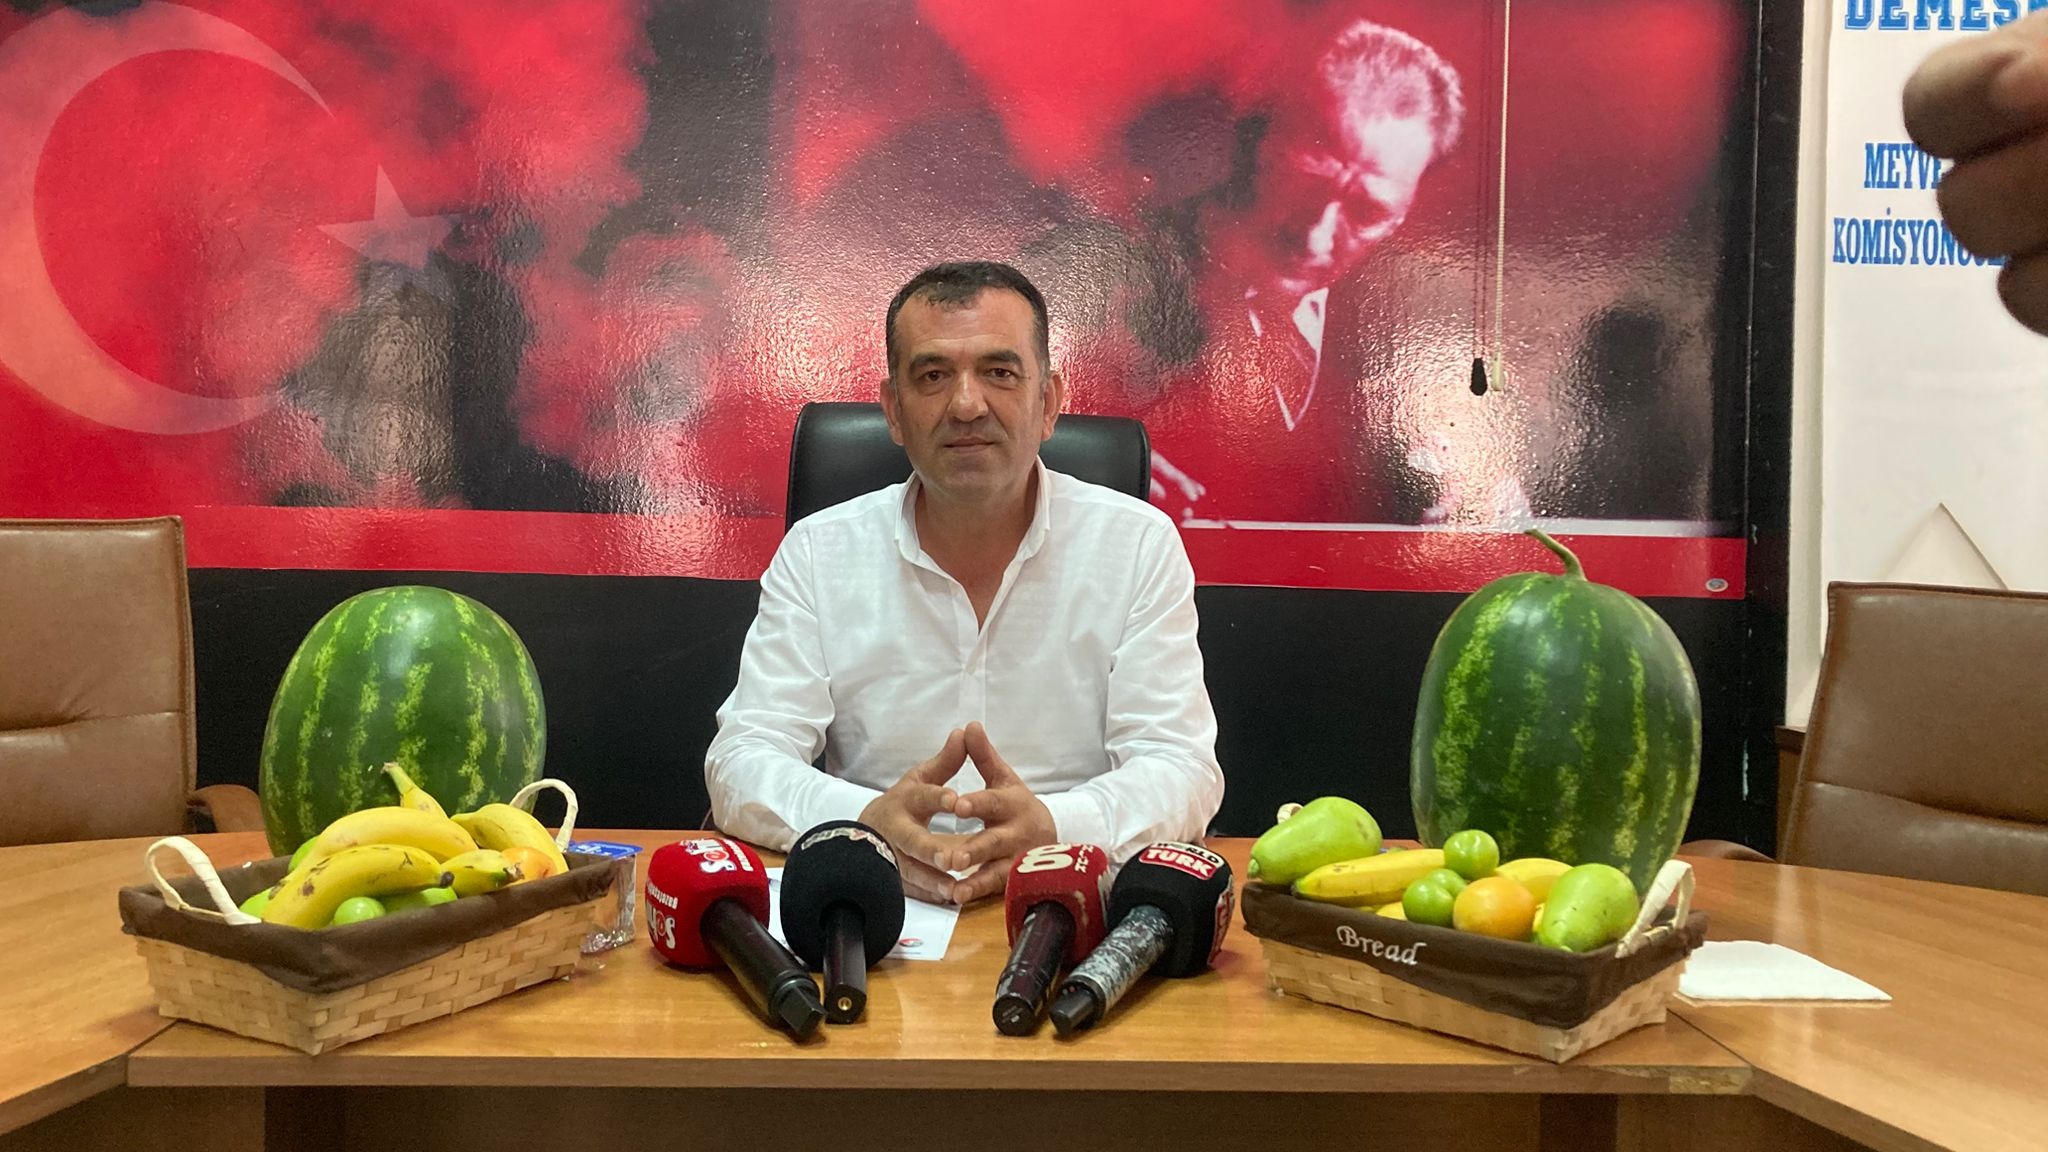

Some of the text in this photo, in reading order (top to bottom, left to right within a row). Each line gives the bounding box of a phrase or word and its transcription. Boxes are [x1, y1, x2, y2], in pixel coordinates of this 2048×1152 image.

[1844, 0, 2048, 30] DEMES
[1832, 207, 2007, 266] KOMİSYON
[1147, 849, 1212, 877] TURK
[1336, 925, 1427, 966] Bread
